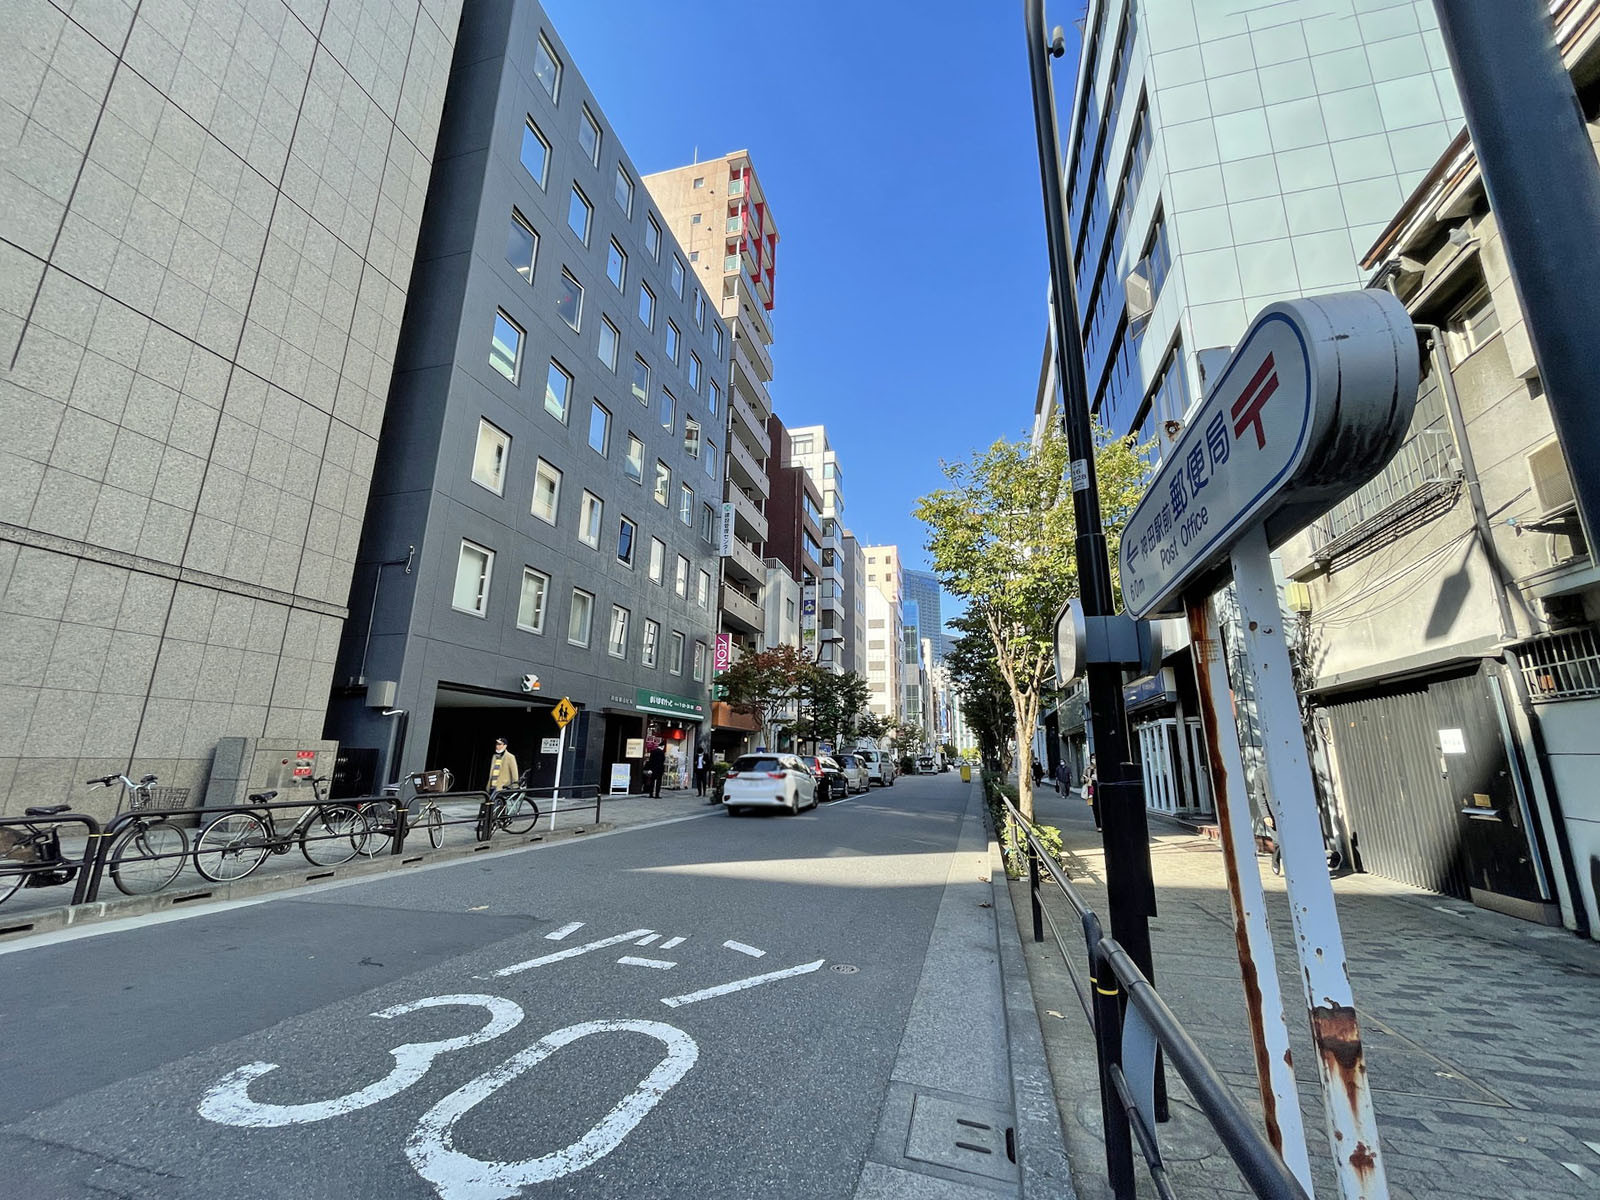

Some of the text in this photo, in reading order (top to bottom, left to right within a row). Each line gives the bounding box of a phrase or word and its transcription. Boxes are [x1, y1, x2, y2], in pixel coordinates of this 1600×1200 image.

[1160, 506, 1209, 571] Post Office
[197, 993, 700, 1200] 30
